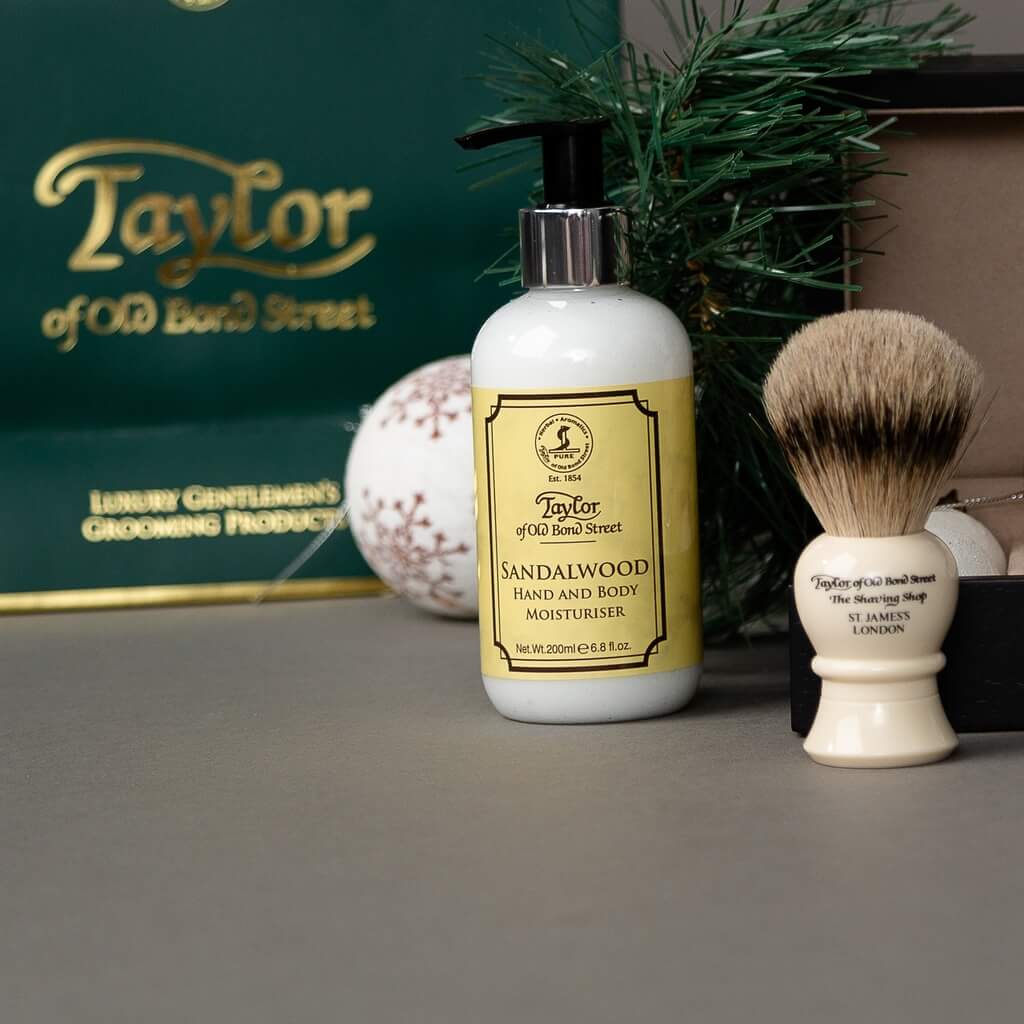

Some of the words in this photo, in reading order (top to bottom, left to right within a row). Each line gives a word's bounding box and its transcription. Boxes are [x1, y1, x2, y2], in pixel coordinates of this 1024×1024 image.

[34, 138, 376, 288] Taylor
[42, 294, 88, 353] of
[86, 293, 158, 335] Old
[162, 292, 257, 336] Bond
[262, 293, 376, 332] Street
[564, 474, 582, 482] 1854
[89, 488, 178, 515] LUXURY
[182, 479, 341, 511] GENTLEMEN'S
[536, 491, 601, 522] Taylor
[81, 513, 221, 542] GROOMING
[516, 523, 528, 541] of
[528, 522, 548, 536] Old
[552, 522, 582, 536] Bond
[585, 521, 623, 534] Street
[501, 558, 649, 580] SANDALWOOD
[811, 575, 853, 591] Taylor
[853, 577, 864, 591] of
[864, 576, 883, 587] Old
[885, 576, 909, 587] Bond
[910, 574, 936, 585] Street
[513, 587, 554, 600] HAND
[558, 588, 592, 600] AND
[598, 584, 639, 598] BODY
[829, 593, 850, 604] The
[854, 593, 900, 609] Shaving
[902, 592, 928, 605] Shop
[526, 606, 626, 621] MOISTURISER
[864, 611, 911, 622] JAMES'S
[853, 625, 905, 635] LONDON
[590, 642, 606, 653] 6.8
